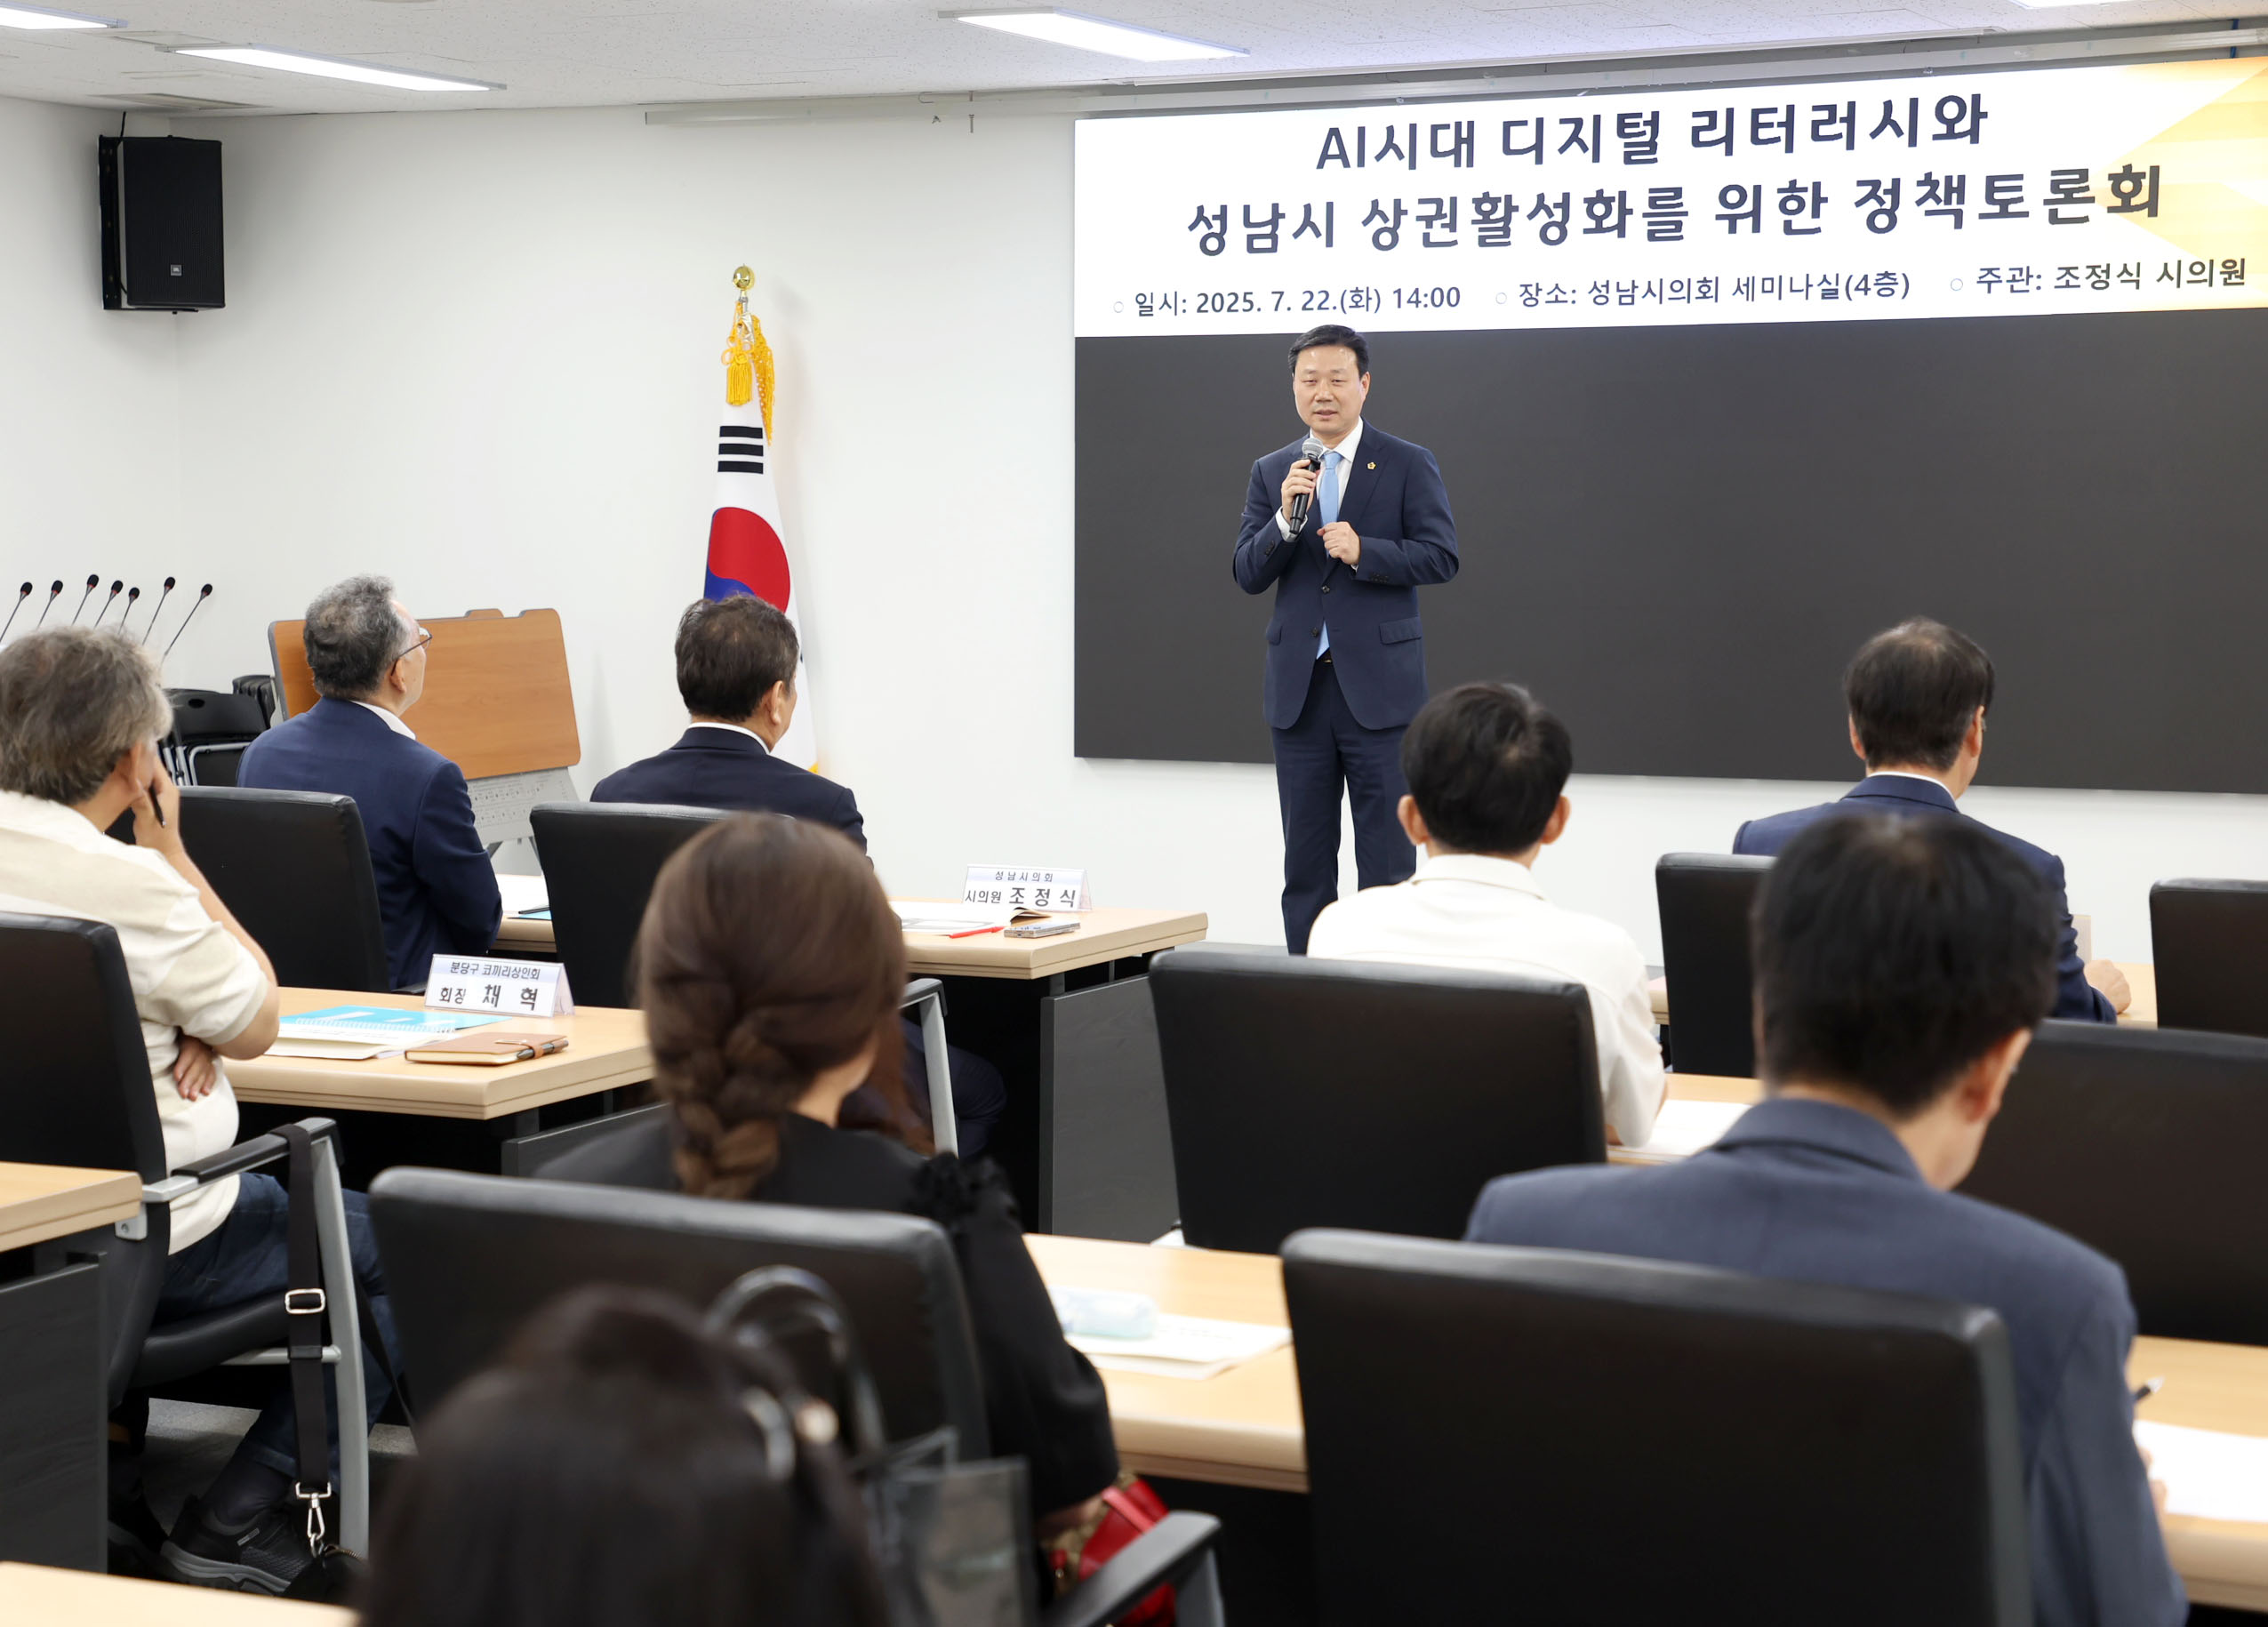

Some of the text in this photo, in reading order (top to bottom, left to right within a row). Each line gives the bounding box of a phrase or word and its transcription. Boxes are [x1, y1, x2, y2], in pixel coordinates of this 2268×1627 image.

[1317, 94, 1988, 170] AI시대 디지털 리터러시와
[1189, 164, 2160, 256] 성남시 상권활성화를 위한 정책토론회
[1519, 271, 1909, 307] 장소: 성남시의회 세미나실(4층)
[1976, 259, 2245, 293] 주관: 조정식 시의원
[1135, 292, 1186, 317] 일시:
[1271, 292, 1291, 311] 7.
[1393, 287, 1460, 309] 14:00
[966, 891, 1001, 903] 시의원
[451, 962, 541, 981] 분당구 코끼리상인회
[439, 987, 467, 1005] 회장
